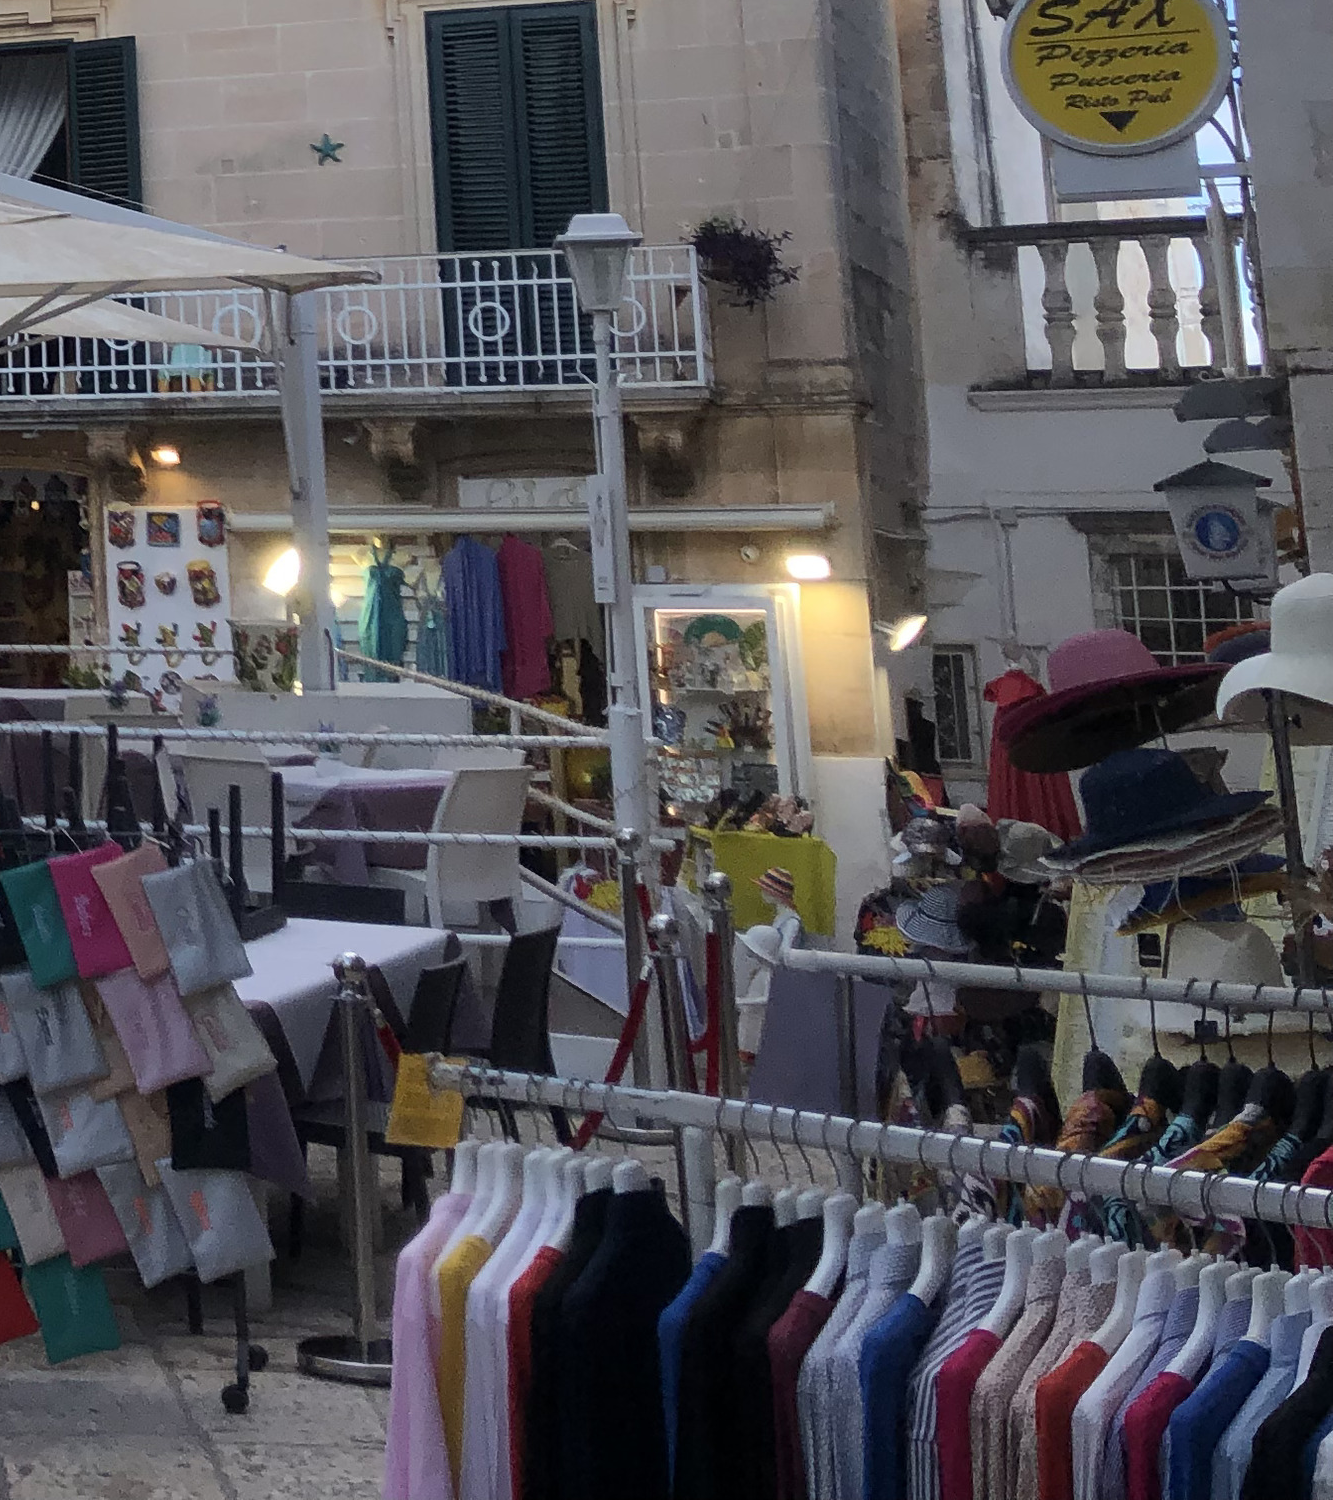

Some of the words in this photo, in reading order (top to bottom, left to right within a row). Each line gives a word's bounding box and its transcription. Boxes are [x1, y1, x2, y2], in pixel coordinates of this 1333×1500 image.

[1035, 40, 1192, 67] Pizzeria
[1064, 93, 1119, 110] Risto
[1127, 88, 1172, 108] Pub
